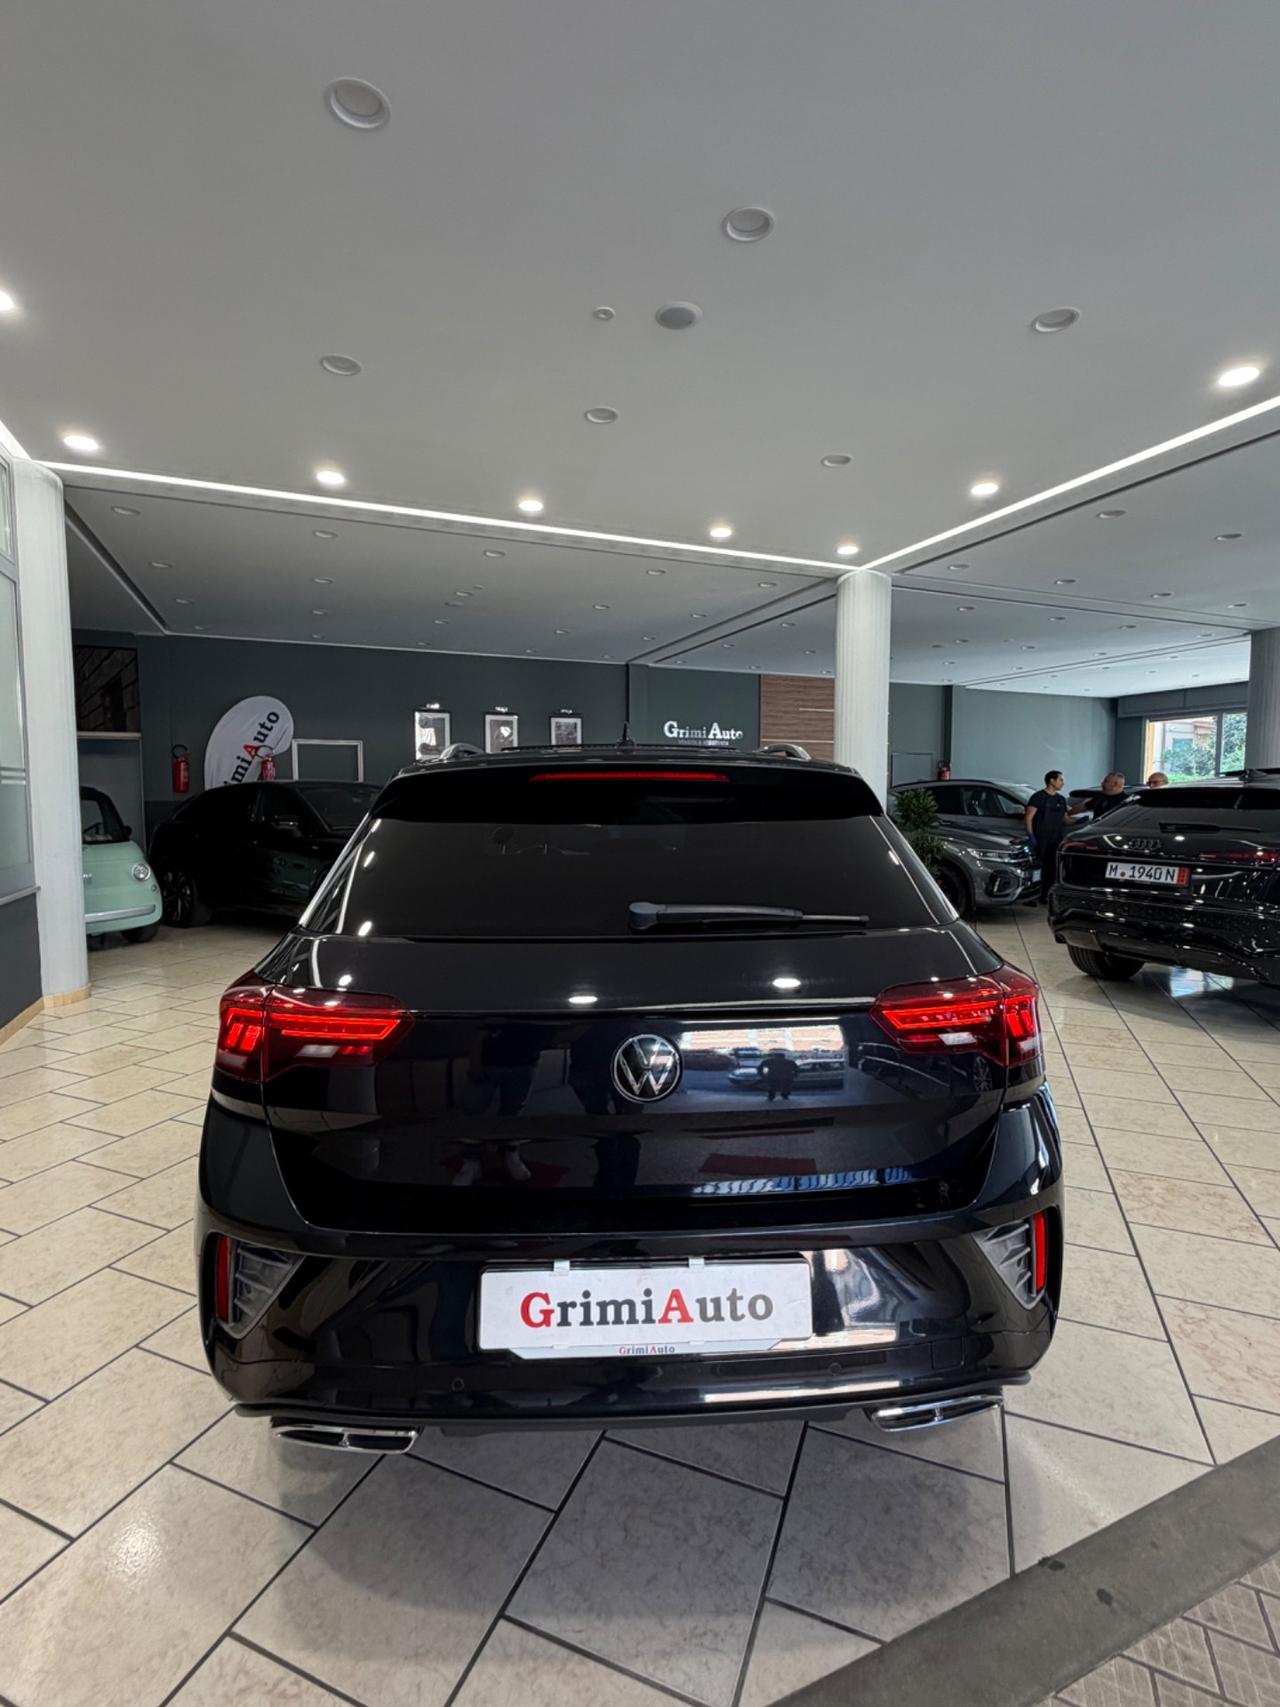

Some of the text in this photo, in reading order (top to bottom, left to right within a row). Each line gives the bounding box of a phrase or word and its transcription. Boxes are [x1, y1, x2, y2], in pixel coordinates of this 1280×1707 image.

[1108, 864, 1118, 877] M
[520, 1288, 774, 1328] GrimiAuto
[618, 1345, 676, 1355] GrimiAuto
